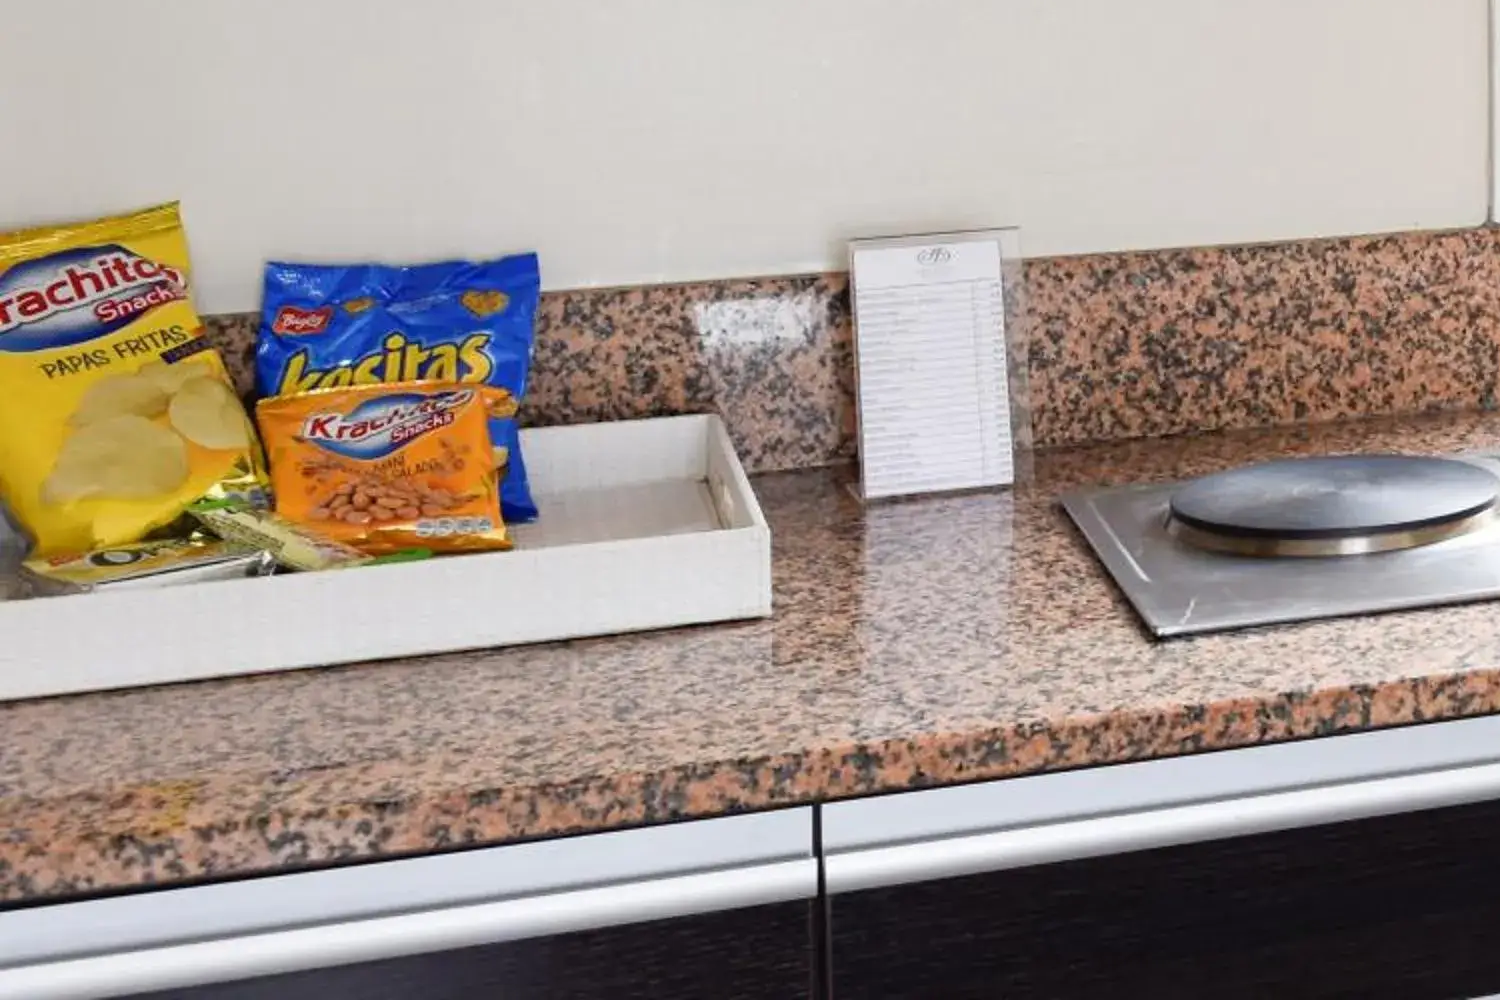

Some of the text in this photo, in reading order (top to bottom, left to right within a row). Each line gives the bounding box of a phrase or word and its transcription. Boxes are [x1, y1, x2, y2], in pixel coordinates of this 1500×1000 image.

[41, 350, 110, 379] PAPAS
[112, 324, 188, 359] FRITAS
[392, 415, 457, 442] Snacks
